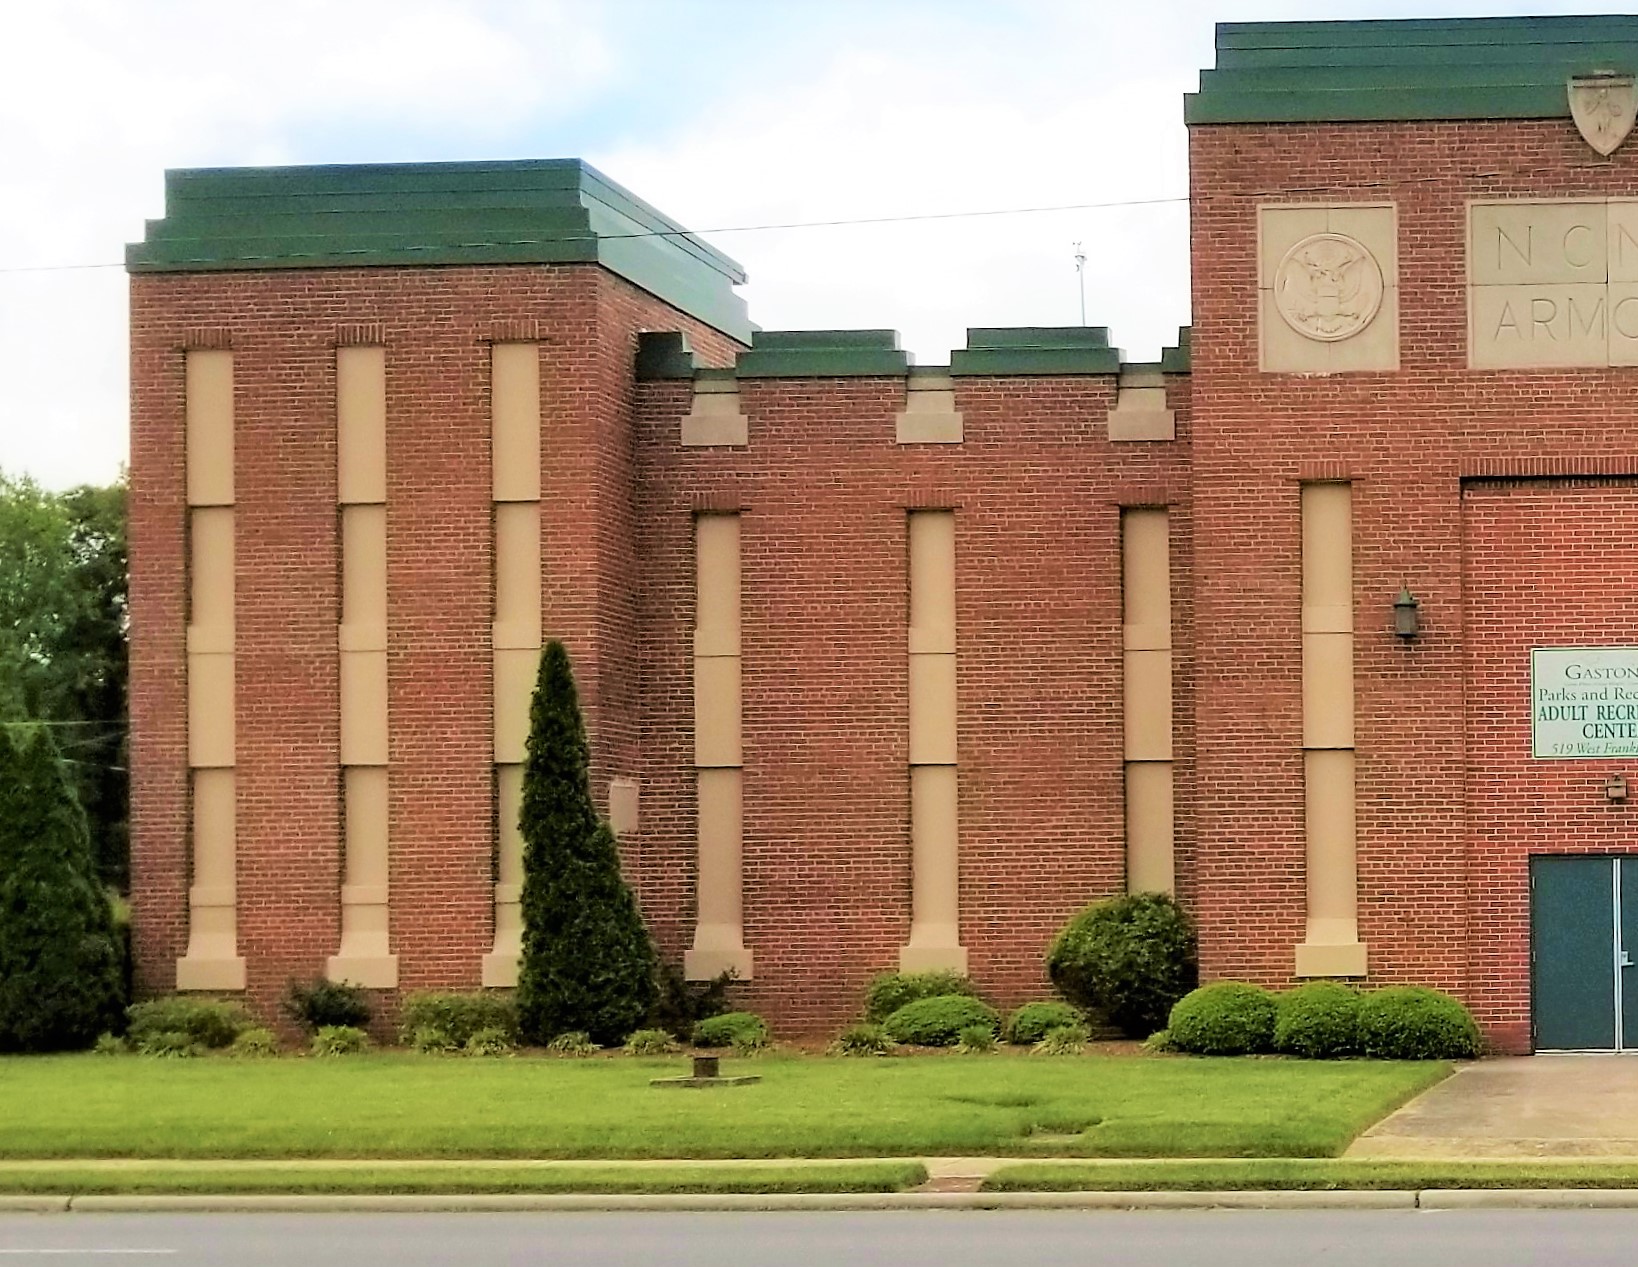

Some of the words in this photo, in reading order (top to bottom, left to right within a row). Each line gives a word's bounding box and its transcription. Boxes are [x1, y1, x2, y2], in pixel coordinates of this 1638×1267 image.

[1539, 688, 1577, 702] Parks
[1581, 687, 1608, 701] and
[1538, 705, 1589, 721] ADULT
[1552, 743, 1574, 755] 519
[1577, 742, 1600, 754] West
